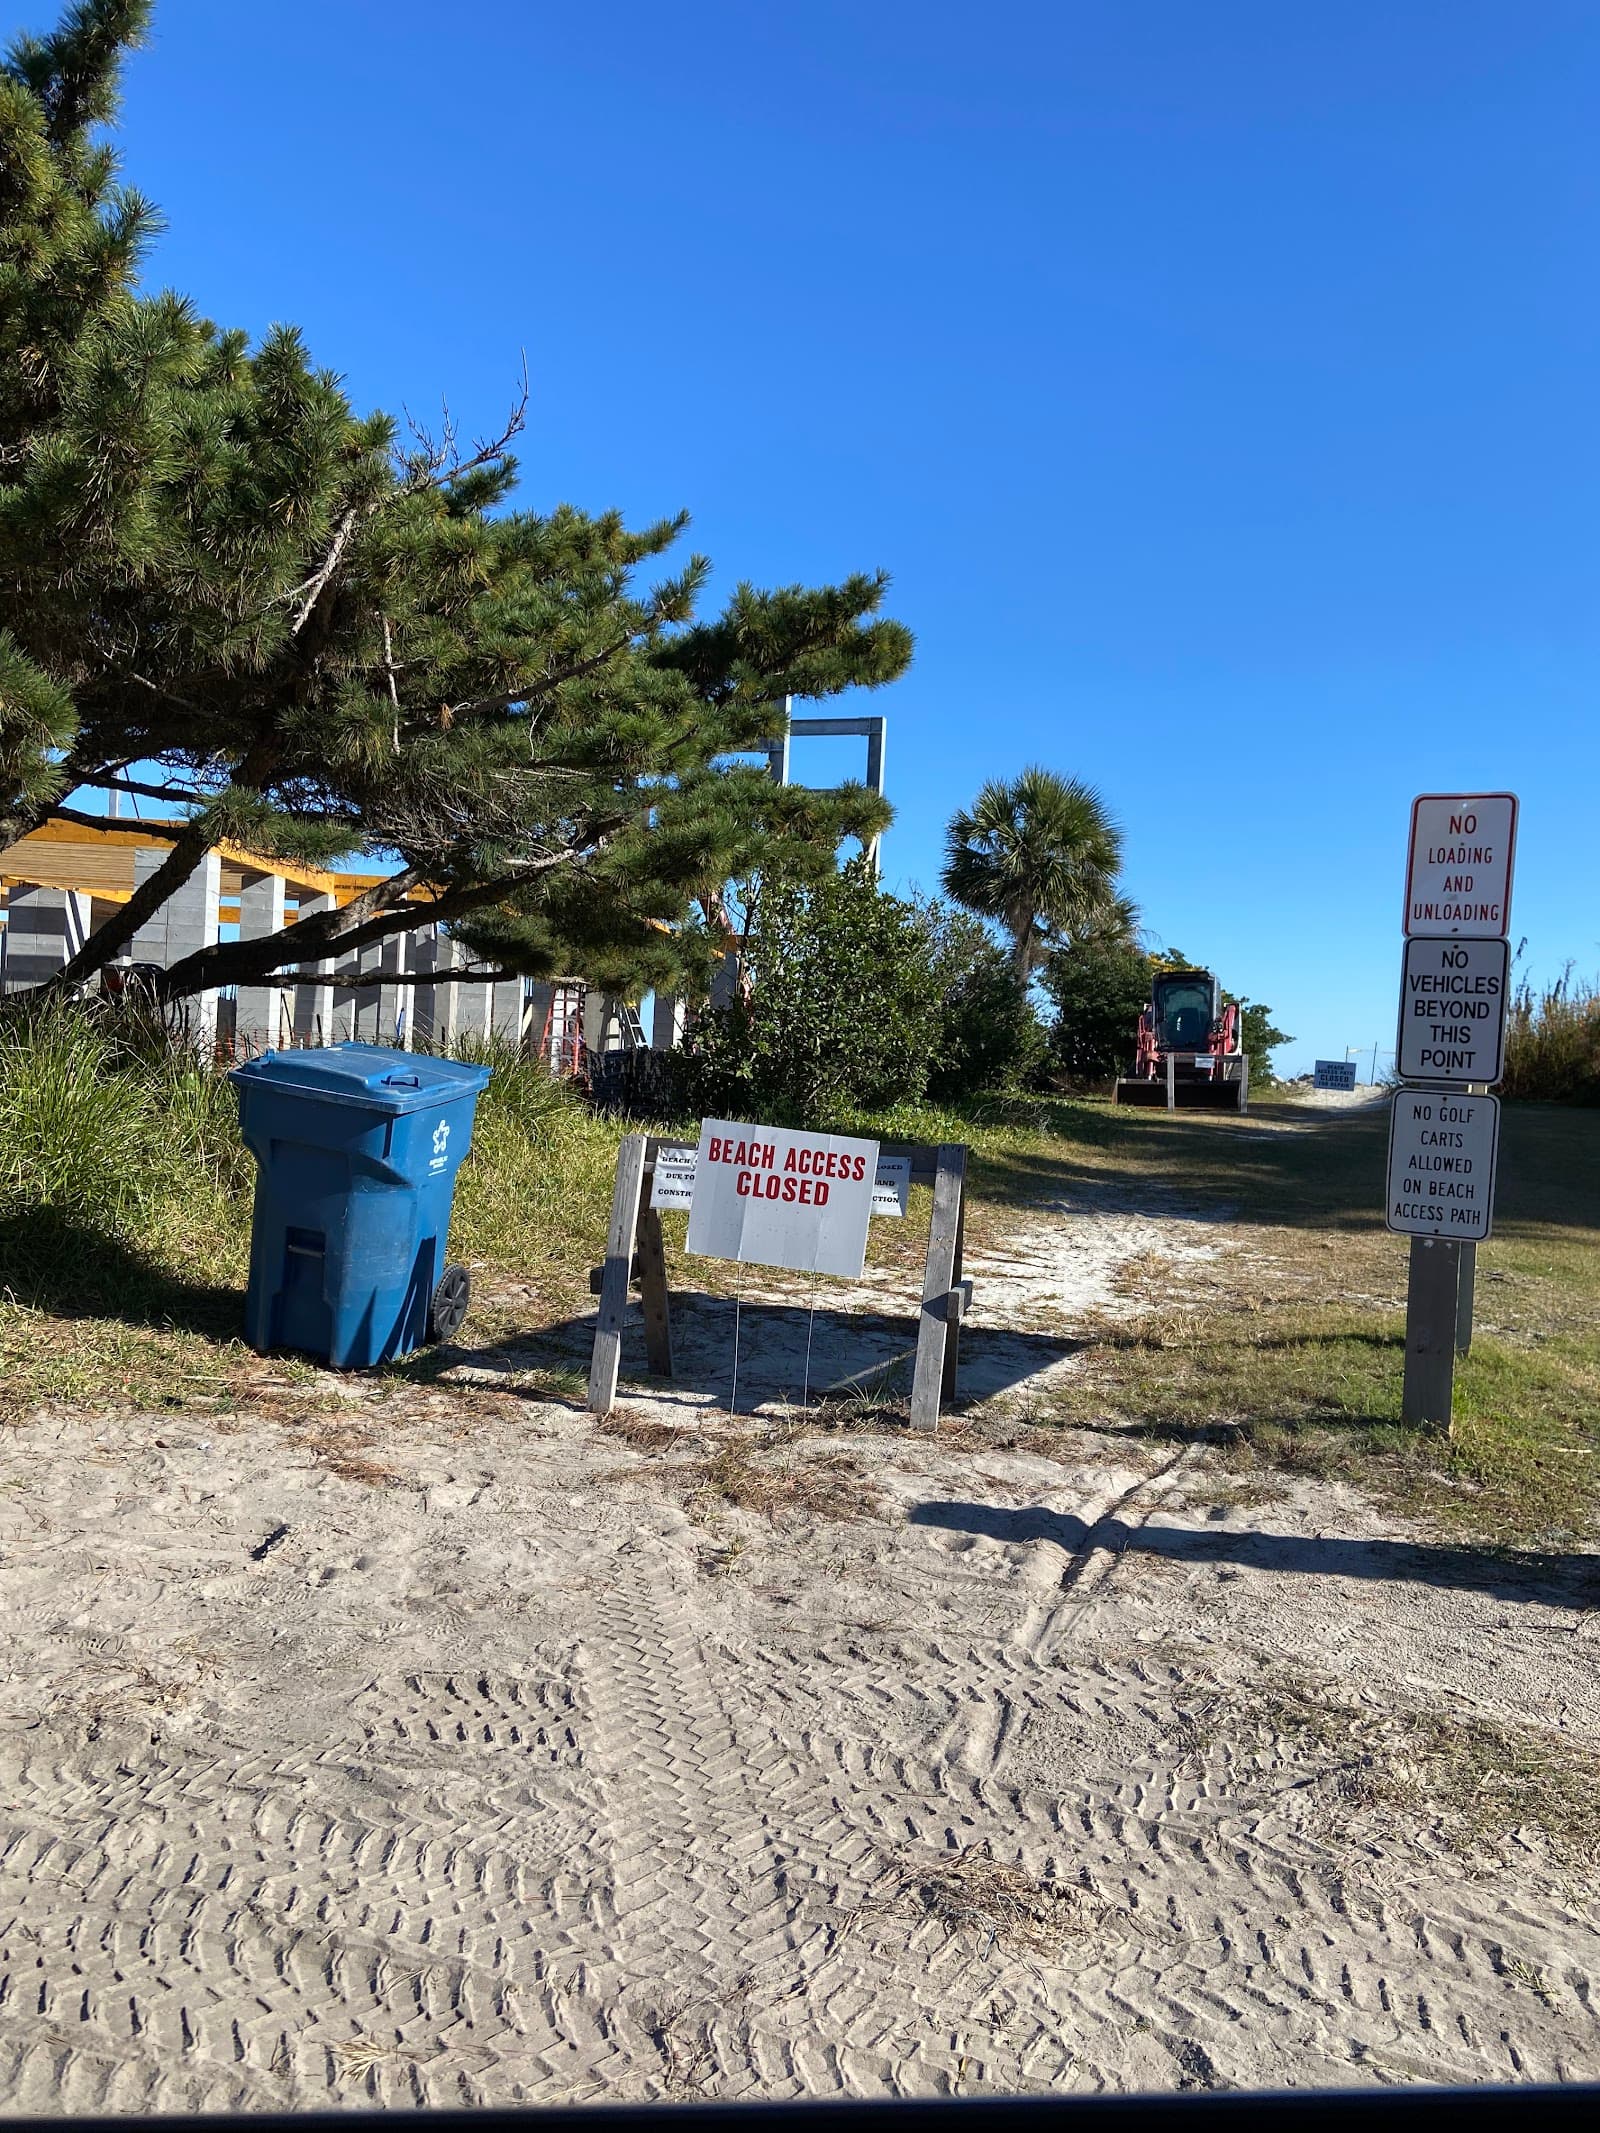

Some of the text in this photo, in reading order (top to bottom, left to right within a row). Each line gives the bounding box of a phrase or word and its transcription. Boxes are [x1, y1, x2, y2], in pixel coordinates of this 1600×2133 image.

[1449, 815, 1477, 834] NO
[1428, 847, 1493, 864] LOADING
[1443, 876, 1474, 892] AND
[1414, 903, 1499, 921] UNLOADING
[1441, 950, 1469, 969] NO
[1410, 974, 1500, 995] VEHICLES
[1414, 1000, 1490, 1019] BEYOND
[1430, 1025, 1471, 1044] THIS
[1420, 1049, 1476, 1069] POINT
[1413, 1105, 1475, 1123] NO GOLF
[1420, 1130, 1463, 1148] CARTS
[708, 1137, 866, 1181] BEACH ACCESS
[1408, 1154, 1472, 1174] ALLOWED
[736, 1171, 830, 1206] CLOSED
[1403, 1178, 1474, 1199] ON BEACH
[1394, 1202, 1481, 1225] ACCESS PATH
